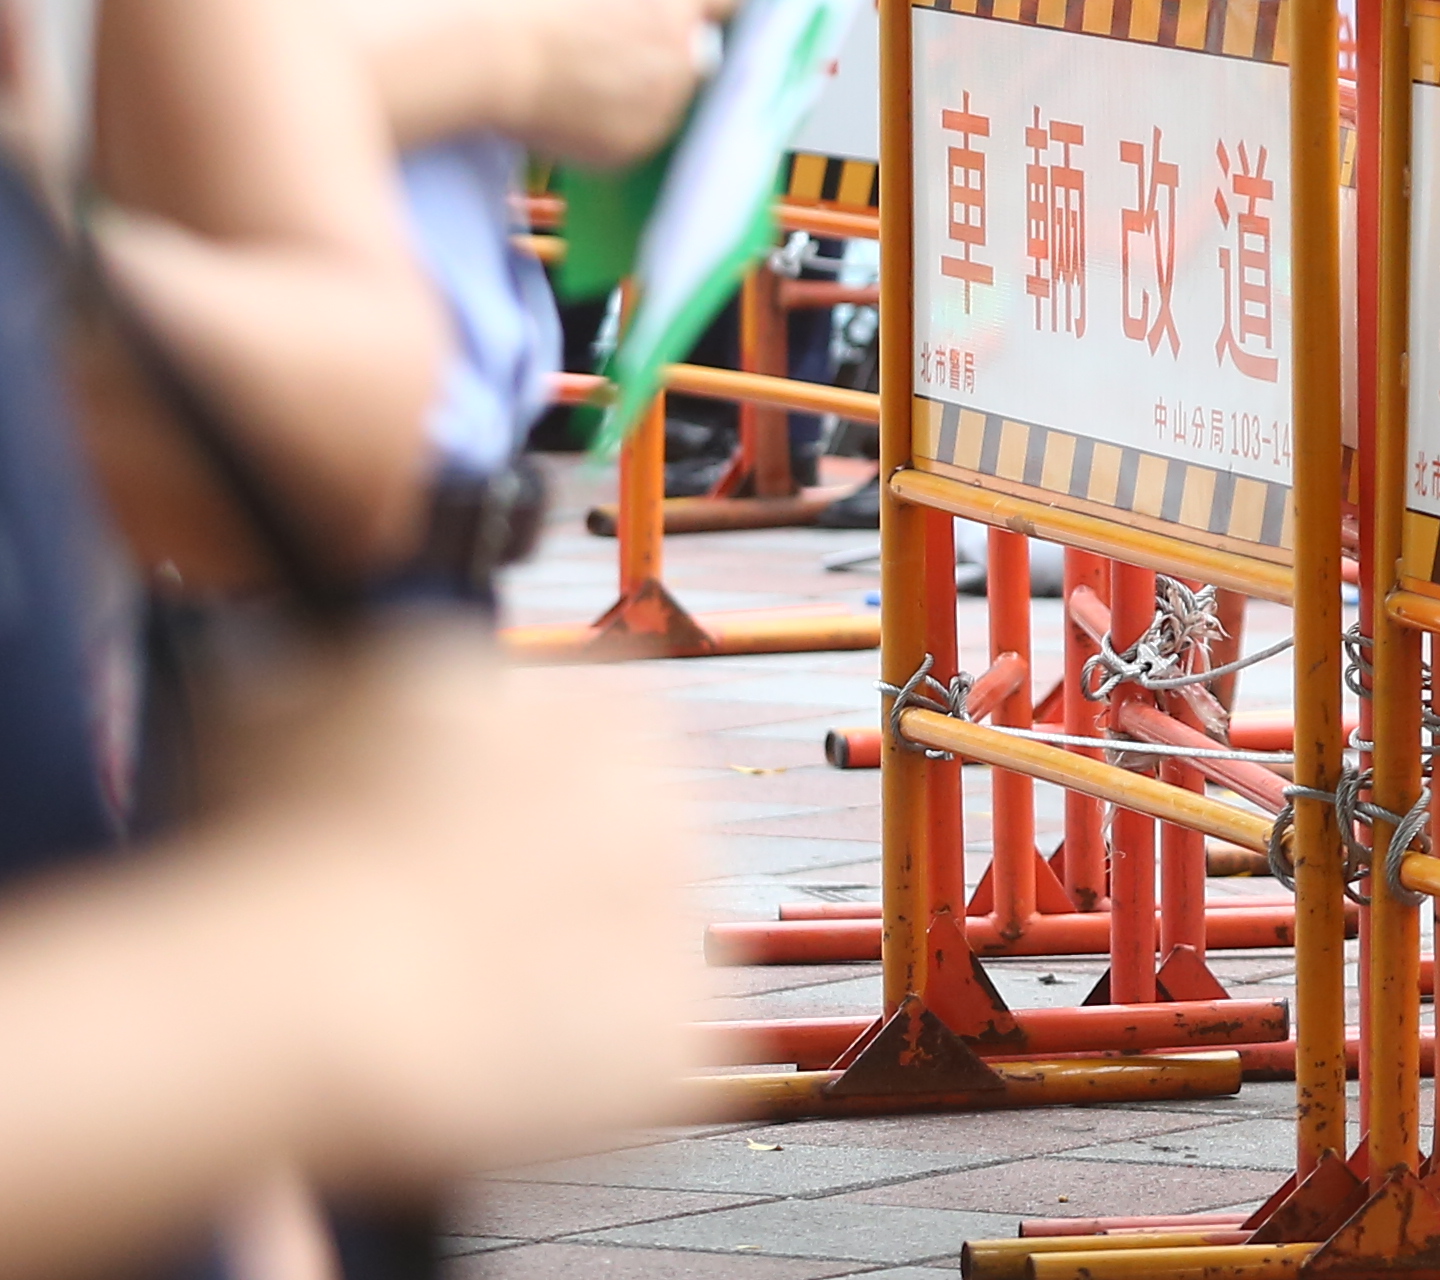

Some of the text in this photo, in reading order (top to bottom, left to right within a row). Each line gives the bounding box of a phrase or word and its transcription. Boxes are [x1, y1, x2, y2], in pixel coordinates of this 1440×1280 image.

[940, 89, 1278, 384] 車輛改道
[920, 342, 976, 394] 北市警局
